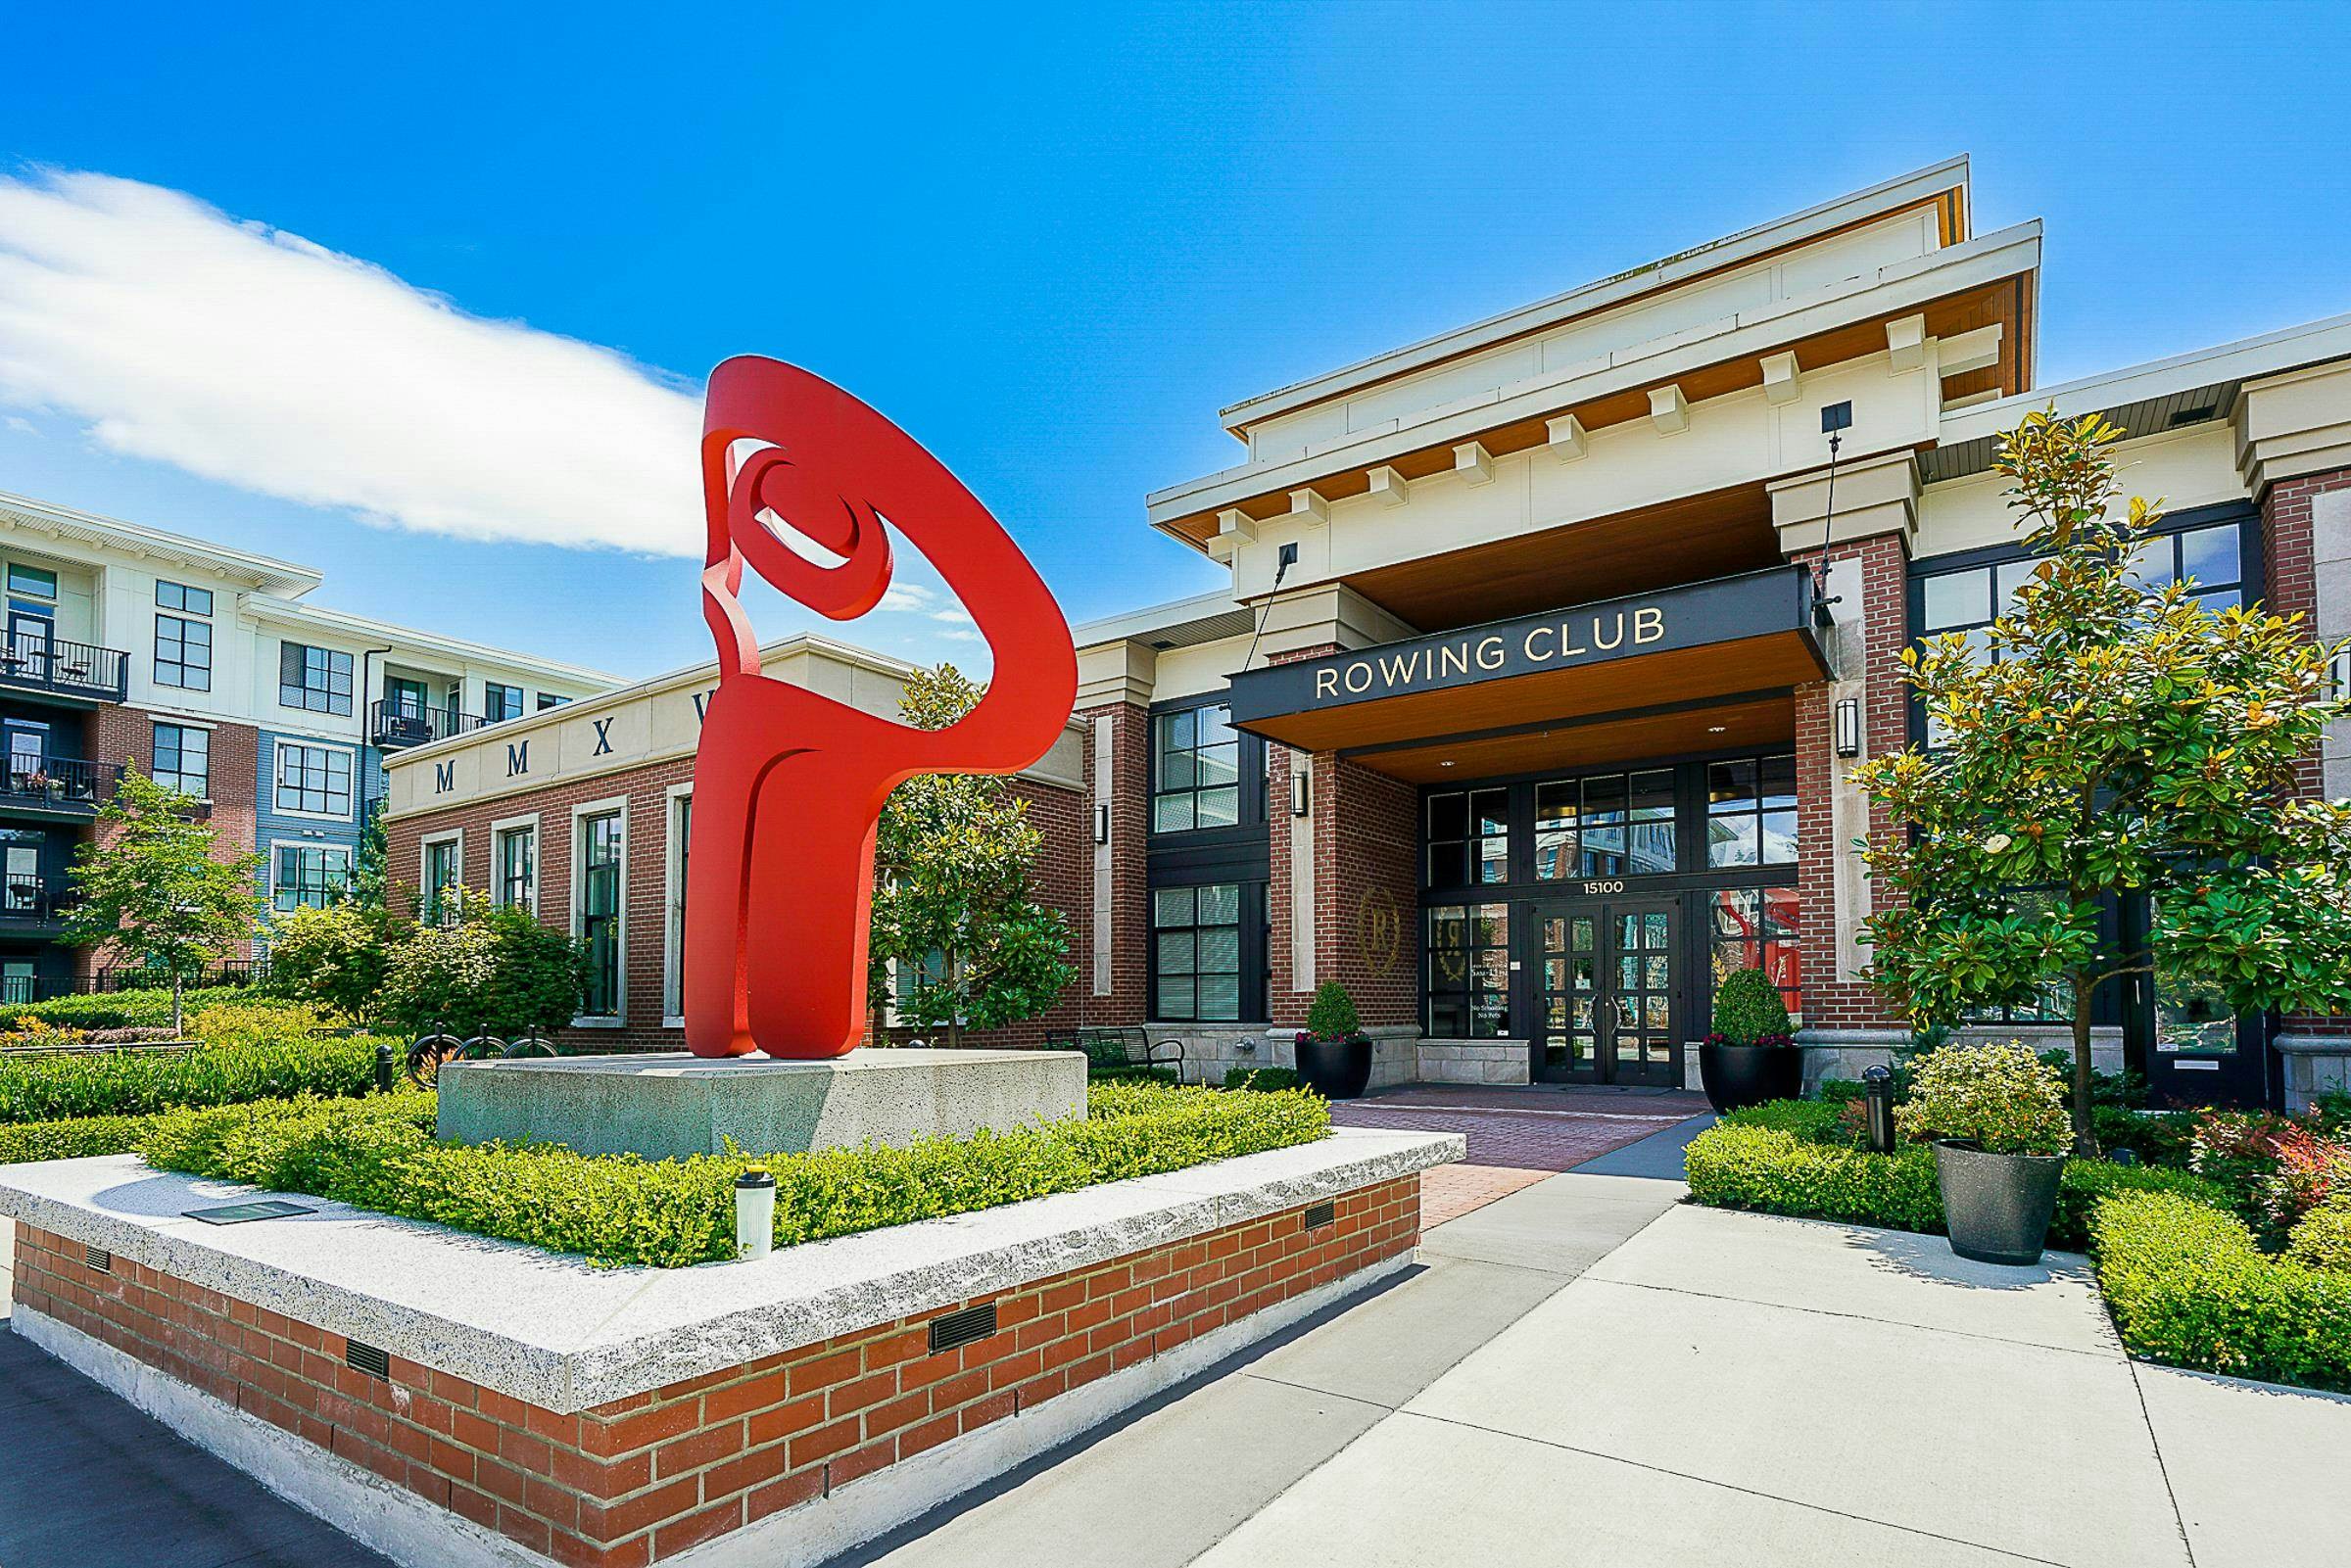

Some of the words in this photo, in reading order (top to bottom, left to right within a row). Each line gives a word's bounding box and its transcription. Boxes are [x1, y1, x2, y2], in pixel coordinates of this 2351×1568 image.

[1316, 637, 1505, 699] ROWING
[1523, 607, 1665, 662] CLUB
[1583, 880, 1624, 894] 15100
[1371, 908, 1387, 951] R
